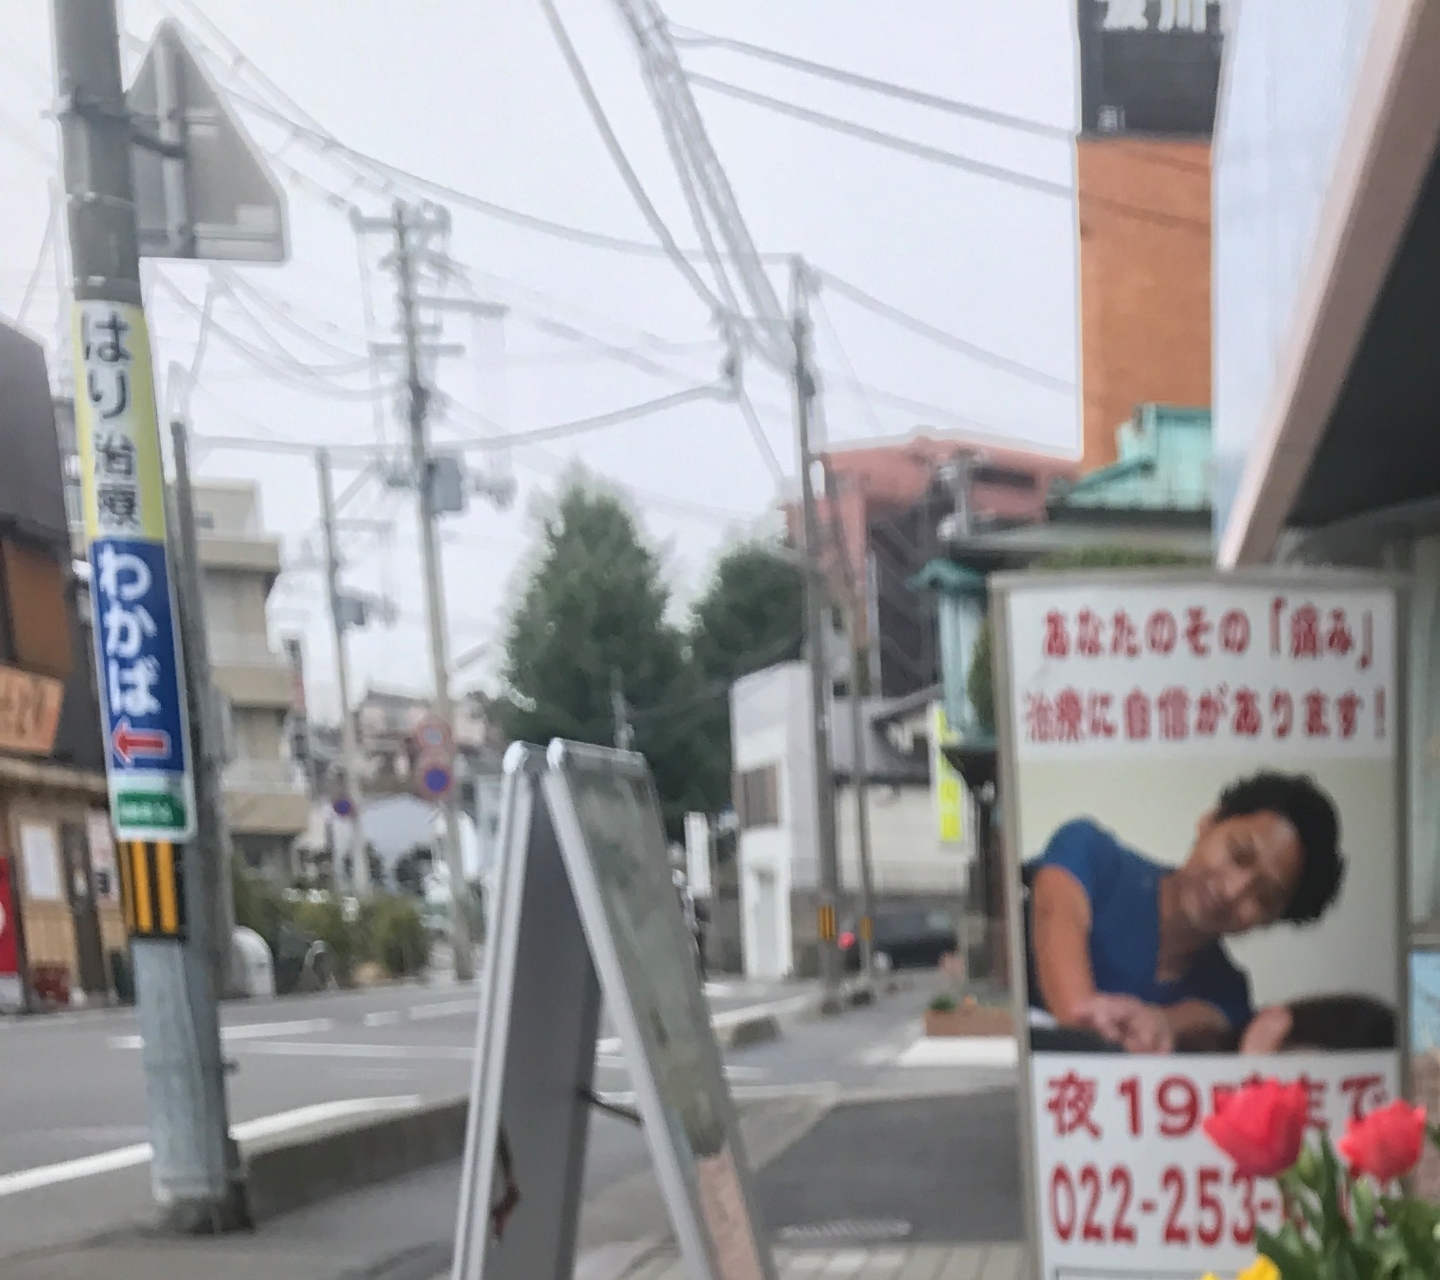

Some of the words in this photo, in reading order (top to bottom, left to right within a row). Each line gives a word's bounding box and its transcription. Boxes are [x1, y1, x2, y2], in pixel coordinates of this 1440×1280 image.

[80, 309, 140, 526] はり治療
[100, 543, 162, 717] わかば
[1043, 595, 1373, 669] あなたのその「痛み」
